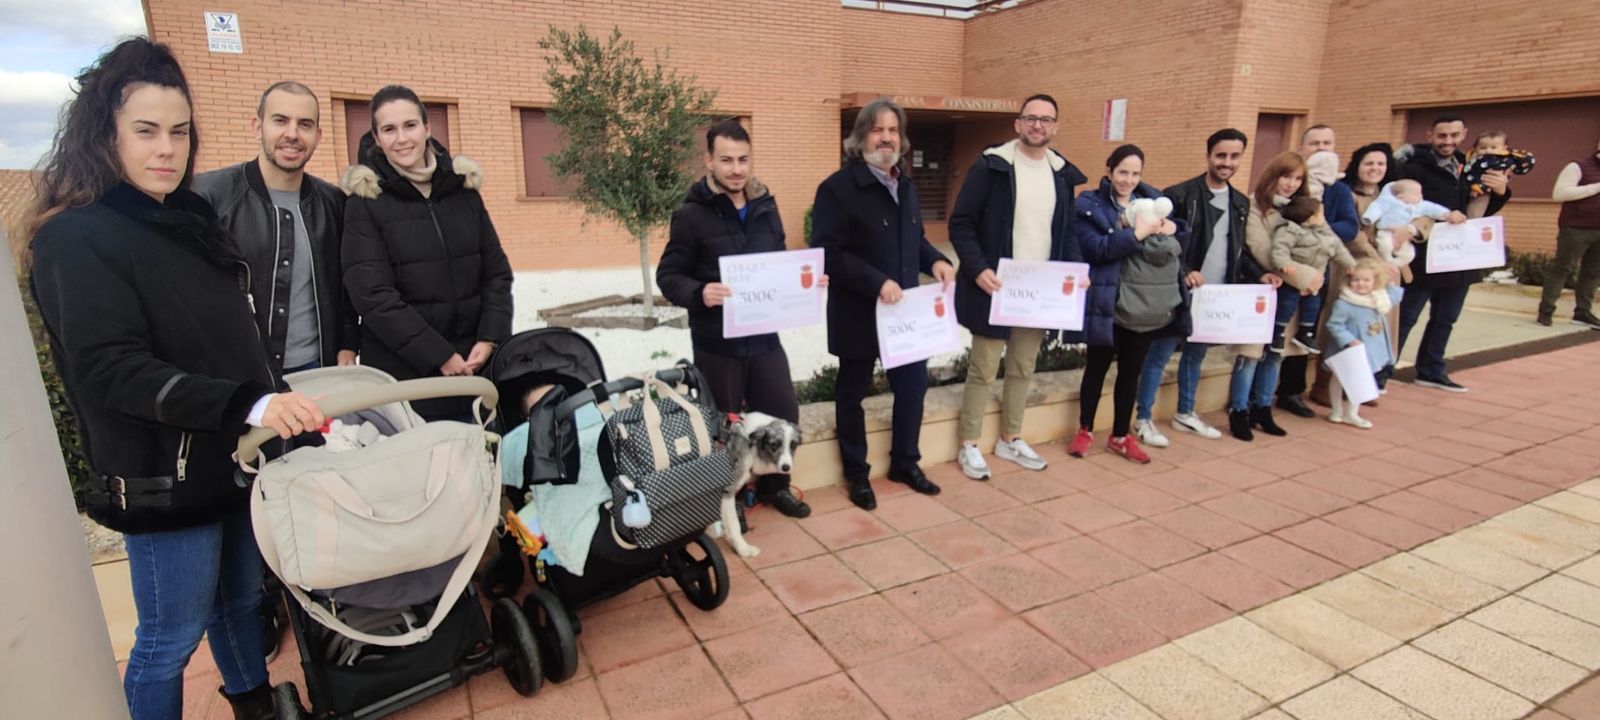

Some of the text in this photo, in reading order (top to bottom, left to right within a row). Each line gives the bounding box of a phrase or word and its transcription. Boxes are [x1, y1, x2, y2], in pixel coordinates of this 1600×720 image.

[893, 96, 1018, 112] CASA CONSISTORIAL
[739, 288, 777, 304] 500€
